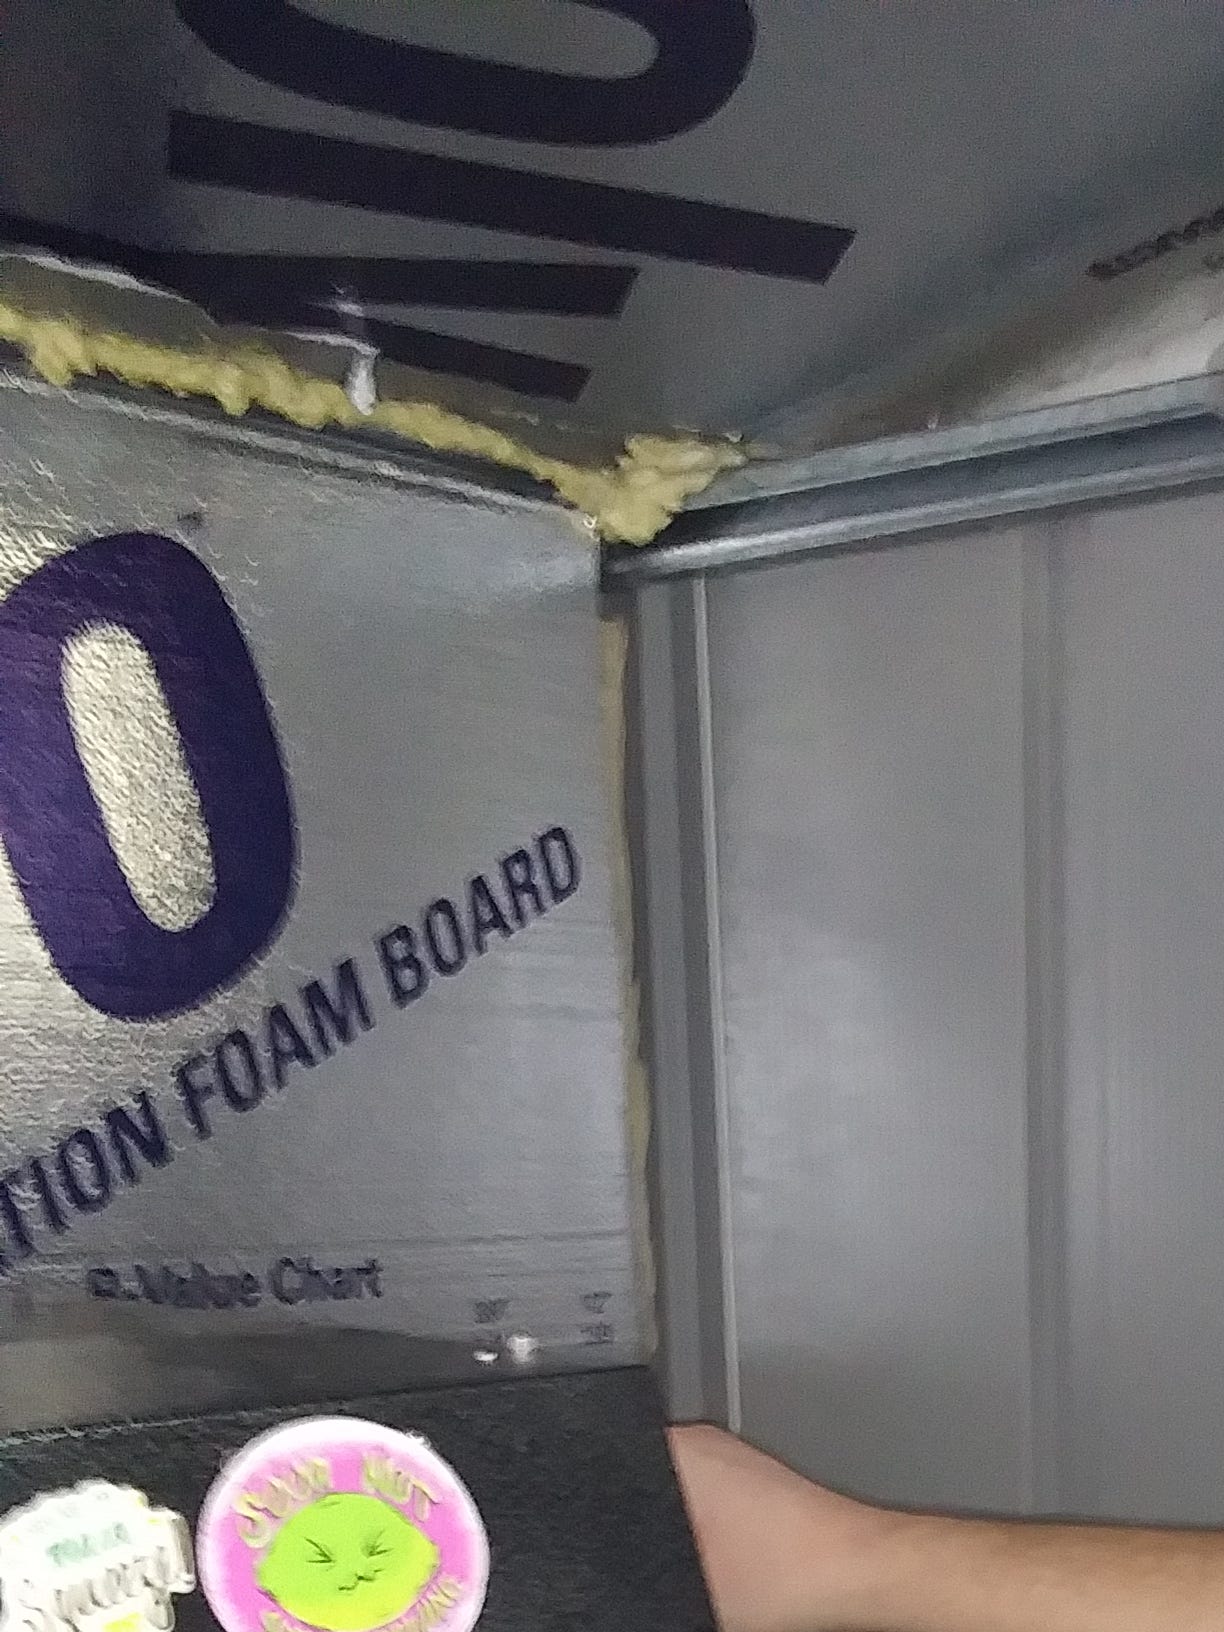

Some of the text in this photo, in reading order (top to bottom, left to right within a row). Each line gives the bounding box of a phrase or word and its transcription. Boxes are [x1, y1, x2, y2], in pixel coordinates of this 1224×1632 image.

[0, 826, 582, 1277] TION FOAM BOARD
